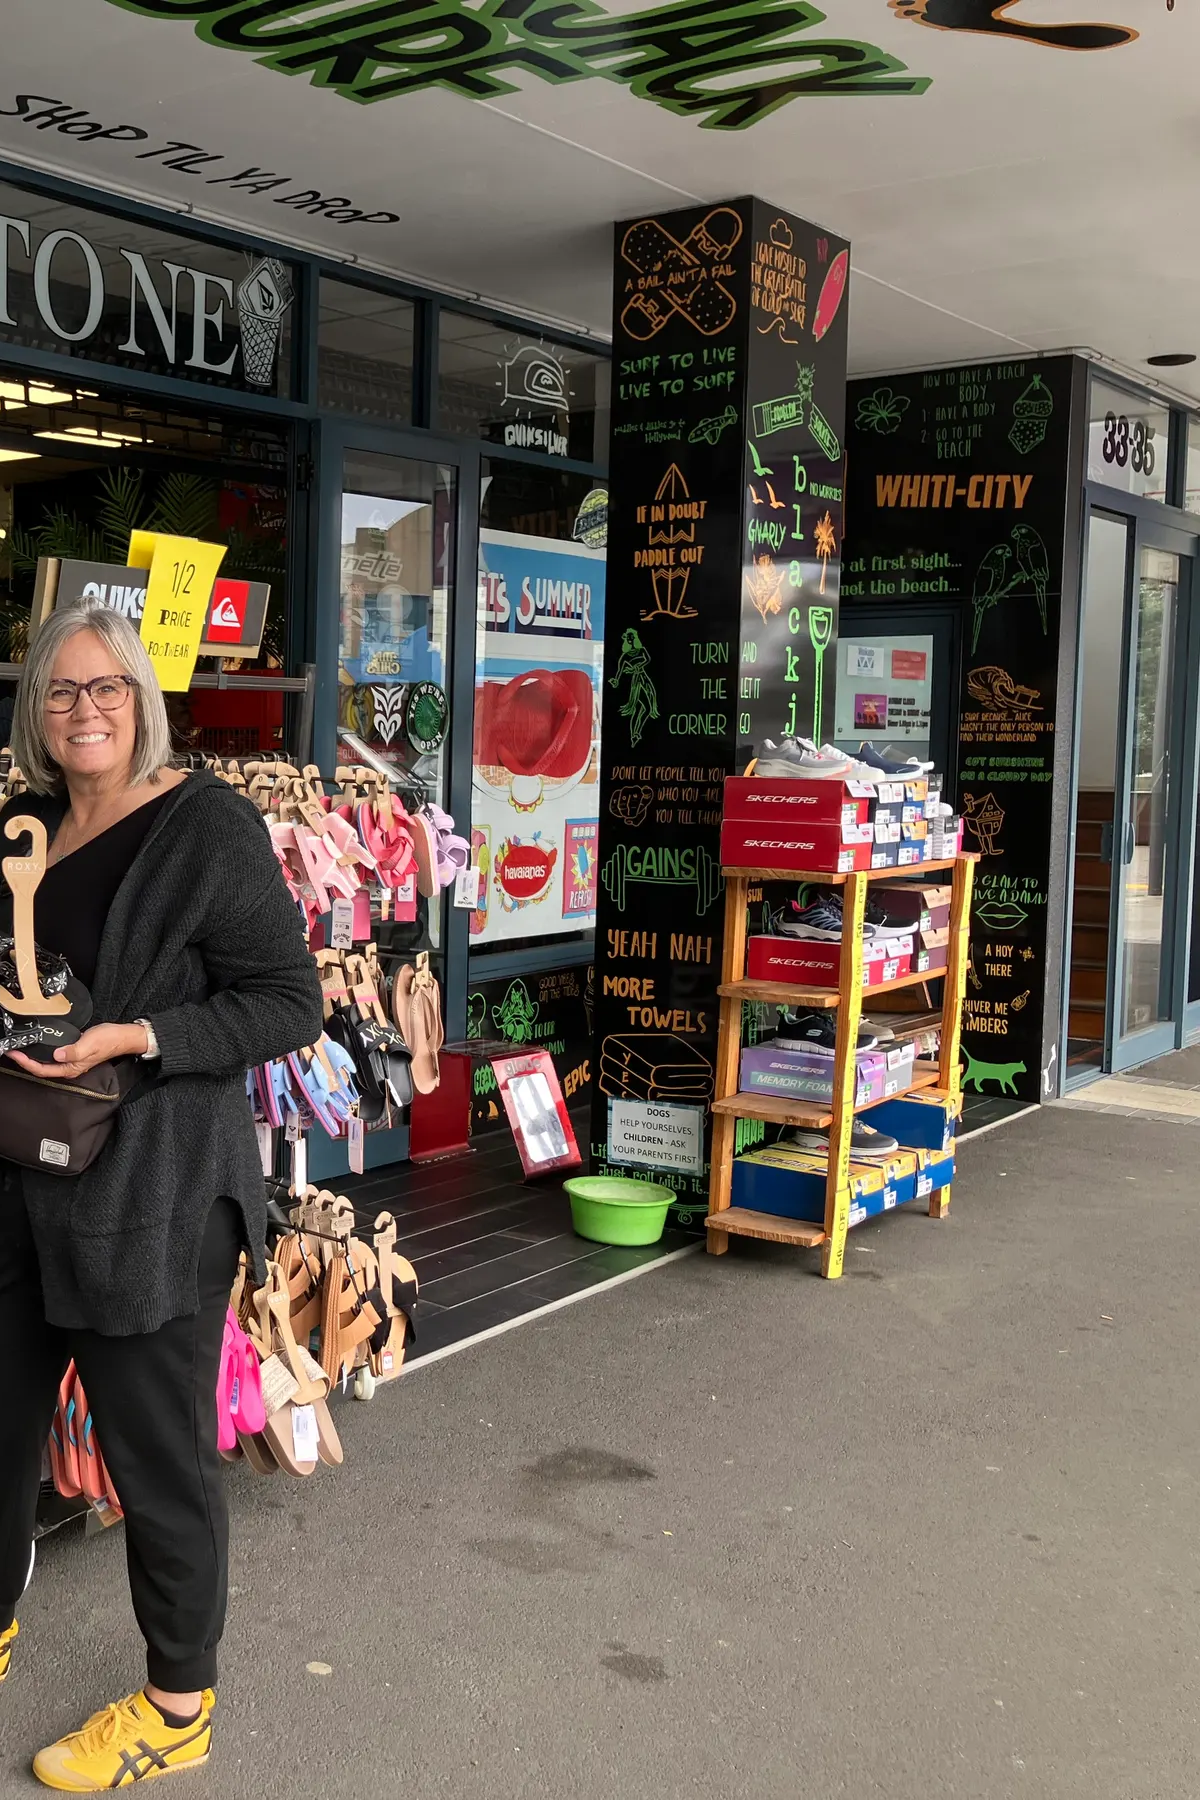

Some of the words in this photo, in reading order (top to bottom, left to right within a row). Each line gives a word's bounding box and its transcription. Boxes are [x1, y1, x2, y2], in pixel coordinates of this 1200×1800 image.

[130, 0, 584, 105] URF
[135, 141, 225, 175] TIL
[205, 166, 293, 195] YA
[272, 187, 402, 227] DROP
[624, 280, 634, 293] A
[637, 275, 664, 290] BAIL
[667, 269, 698, 286] AIN'T
[699, 266, 708, 281] A
[712, 263, 737, 278] FAIL
[621, 354, 661, 379] SURF
[668, 352, 694, 371] TO
[703, 346, 737, 365] LIVE
[620, 382, 651, 400] LIVE
[659, 378, 685, 397] TO
[693, 370, 737, 392] SURF
[923, 373, 941, 389] HOW
[945, 371, 956, 386] TO
[960, 369, 982, 384] HAVE
[986, 367, 992, 381] A
[997, 363, 1026, 380] BEACH
[959, 383, 987, 403] BODY
[936, 405, 957, 421] HAVE
[962, 404, 968, 419] A
[973, 401, 996, 417] BODY
[936, 427, 948, 442] GO
[952, 425, 963, 440] TO
[968, 423, 983, 438] THE
[937, 439, 972, 460] BEACH
[1103, 410, 1156, 477] 33-35
[875, 474, 1034, 510] WHITI-CITY
[636, 504, 648, 524] IF
[651, 503, 665, 522] IN
[669, 500, 708, 521] DOUBT
[747, 517, 787, 554] GNARLY
[634, 548, 677, 568] PADDLE
[680, 545, 705, 566] OUT
[849, 557, 866, 572] at
[871, 555, 907, 571] first
[172, 559, 196, 599] 1/2
[870, 579, 896, 595] the
[515, 576, 593, 631] SUMMER
[157, 608, 193, 628] PRICE
[147, 640, 190, 658] FOOTWEAR
[689, 641, 729, 664] TURN
[741, 640, 758, 663] AND
[699, 678, 728, 700] THE
[739, 677, 754, 700] LET
[408, 694, 419, 720] YES
[964, 712, 980, 722] SURF
[1014, 712, 1032, 722] ALICE
[668, 713, 727, 736] CORNER
[738, 712, 751, 736] GO
[986, 722, 999, 732] THE
[1000, 722, 1017, 732] ONLY
[1017, 722, 1044, 732] PERSON
[1045, 722, 1054, 732] TO
[419, 733, 444, 751] OPEN
[975, 732, 994, 742] THEIR
[995, 732, 1037, 743] WONDERLAND
[610, 765, 637, 781] DONT
[639, 765, 653, 781] LET
[655, 765, 687, 782] PEOPLE
[688, 766, 708, 782] TELL
[708, 766, 726, 783] YOU
[986, 771, 1028, 782] CLOUDY
[1030, 771, 1053, 782] DAY
[657, 786, 679, 802] WHO
[681, 787, 699, 803] YOU
[745, 794, 818, 805] SKECHERS
[655, 808, 673, 824] YOU
[677, 808, 696, 825] TELL
[742, 839, 816, 850] SKECHERS
[7, 862, 41, 872] ROXY
[504, 863, 548, 881] havaianas
[626, 845, 696, 879] GAINS
[981, 874, 1019, 889] GLAM
[1022, 876, 1039, 889] TO
[974, 888, 996, 901] IVE
[999, 888, 1008, 903] A
[1010, 889, 1048, 905] DAMN
[607, 928, 657, 960] YEAH
[669, 932, 712, 965] NAH
[984, 943, 992, 957] A
[995, 944, 1014, 958] HOY
[767, 957, 835, 970] SKECHERS
[984, 962, 1013, 978] THERE
[603, 974, 655, 1002] MORE
[961, 999, 991, 1014] SHIVER
[994, 1001, 1009, 1016] ME
[626, 1005, 707, 1034] TOWELS
[961, 1016, 1009, 1035] IMBERS
[769, 1061, 827, 1075] SKECHERS
[563, 1059, 591, 1099] EPIC
[756, 1074, 805, 1088] MEMORY
[646, 1107, 671, 1118] DOGS
[620, 1118, 640, 1127] HELP
[641, 1120, 695, 1136] YOURSELVES,
[623, 1132, 664, 1145] CHILDREN
[670, 1139, 687, 1148] ASK
[590, 1142, 608, 1159] Lif
[612, 1144, 636, 1155] YOUR
[637, 1148, 673, 1161] PARENTS
[674, 1154, 697, 1164] FIRST
